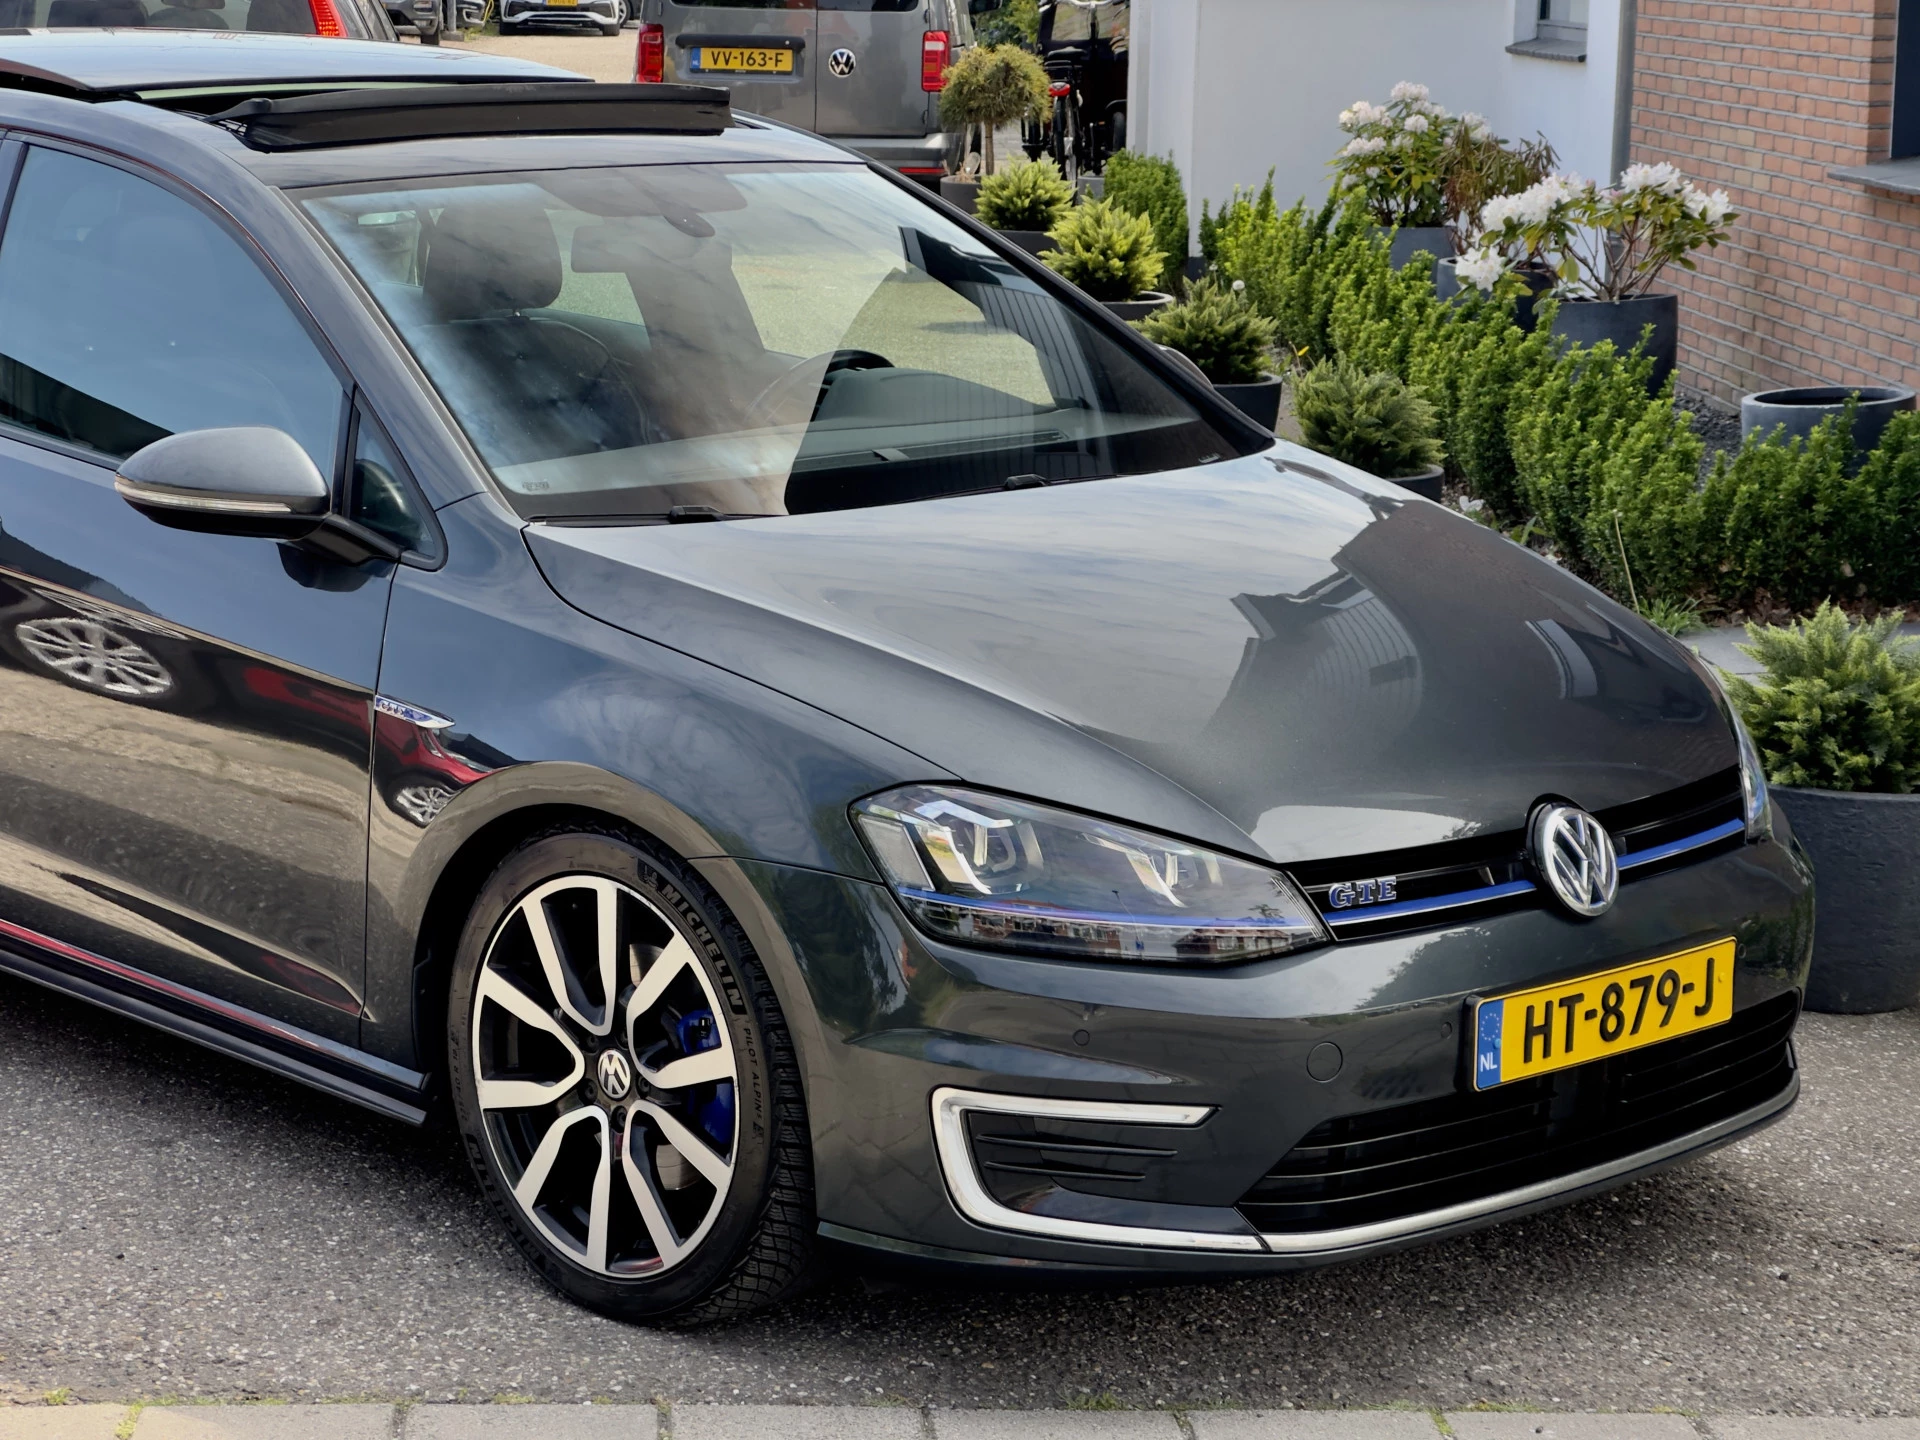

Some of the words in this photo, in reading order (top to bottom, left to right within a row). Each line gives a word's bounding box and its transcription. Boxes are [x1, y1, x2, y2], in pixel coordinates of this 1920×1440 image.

[711, 51, 784, 68] VV-163-F
[1329, 876, 1397, 909] GTE
[661, 881, 743, 1008] MICHELIN
[1523, 957, 1715, 1064] HT-879-J
[743, 1028, 757, 1066] PILOT
[1480, 1051, 1498, 1073] NL
